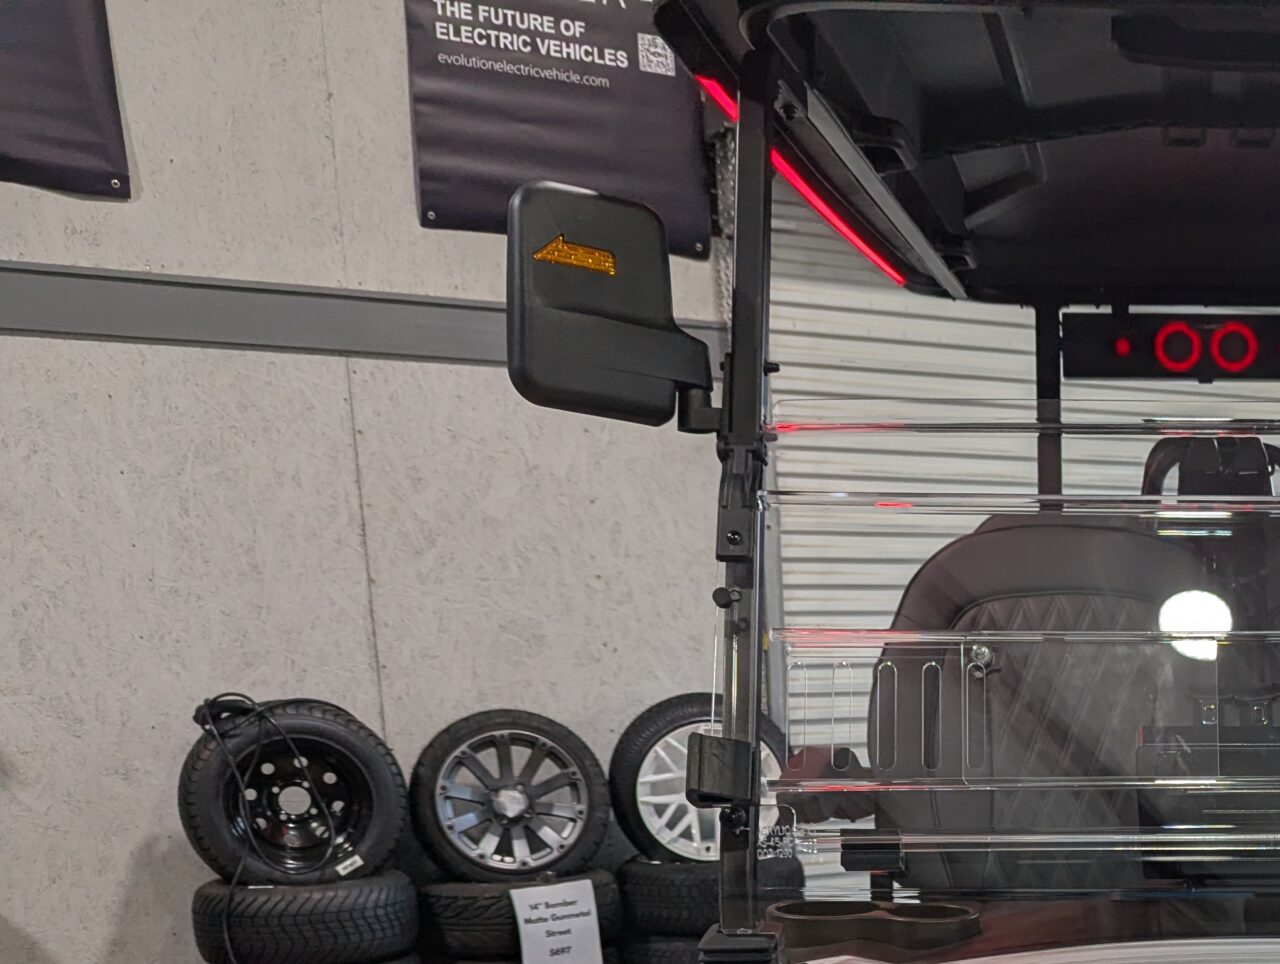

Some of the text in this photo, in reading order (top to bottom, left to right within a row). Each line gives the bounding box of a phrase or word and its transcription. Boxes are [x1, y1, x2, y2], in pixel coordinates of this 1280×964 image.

[433, 0, 473, 21] THE
[478, 5, 555, 34] FUTURE
[560, 20, 586, 38] OF
[435, 22, 629, 69] ELECTRIC VEHICLES
[438, 53, 610, 88] evolutionelectricvehicle.com
[545, 928, 572, 938] Street
